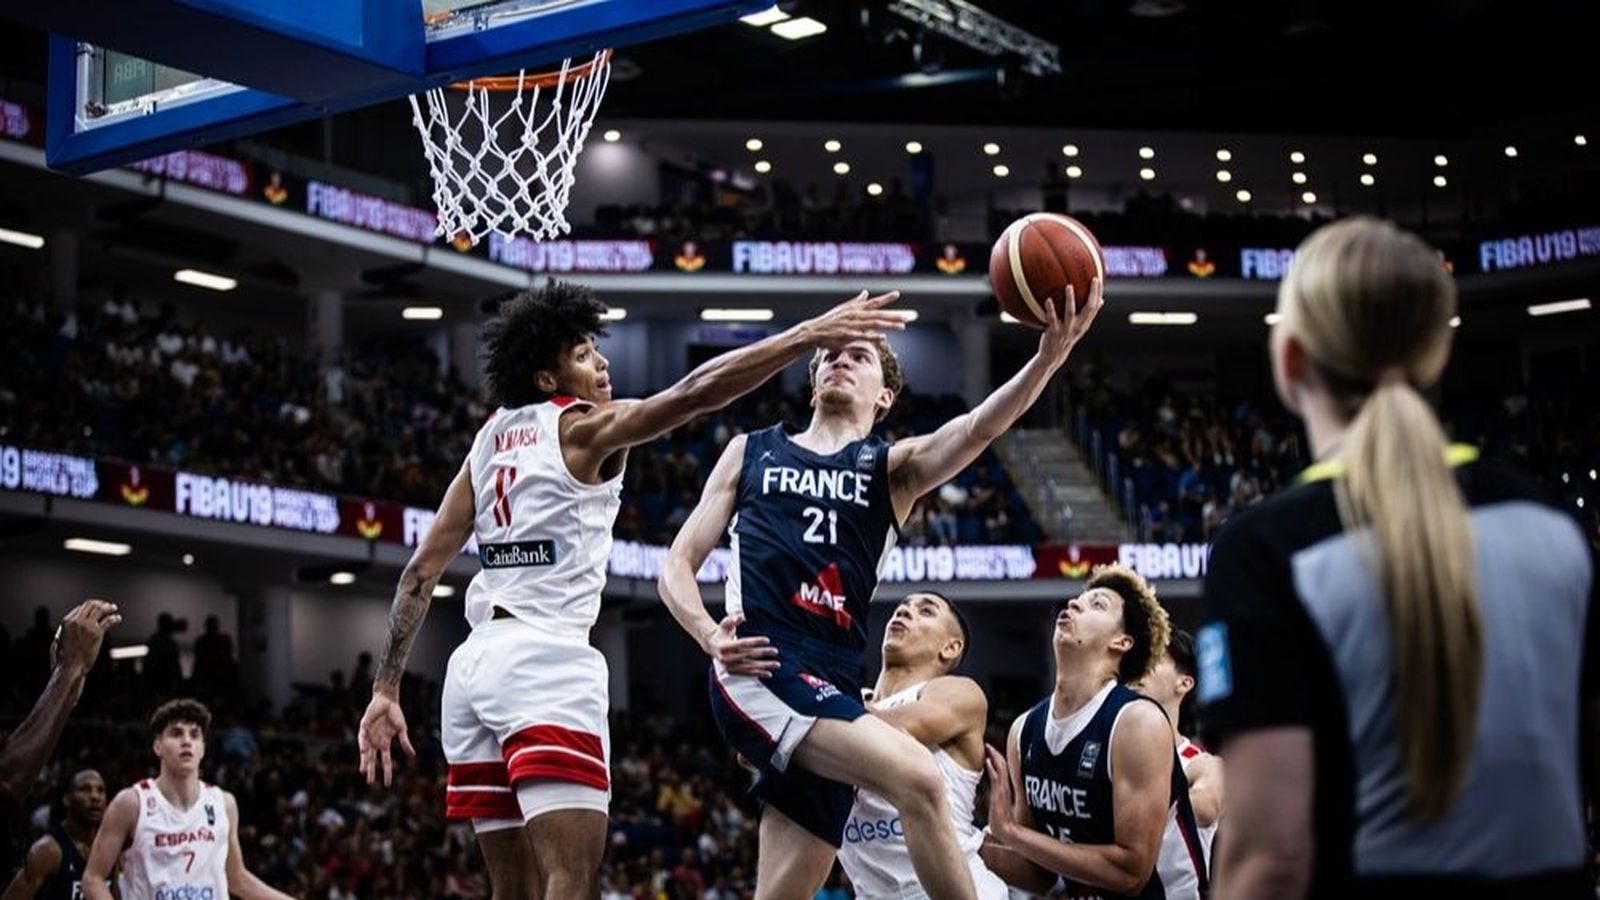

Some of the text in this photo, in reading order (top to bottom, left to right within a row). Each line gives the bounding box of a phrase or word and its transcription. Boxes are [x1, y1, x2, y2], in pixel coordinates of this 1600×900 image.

[732, 240, 793, 273] FIBA
[793, 240, 840, 273] U19
[1480, 234, 1535, 272] FIBA
[1535, 229, 1577, 263] U19
[175, 471, 274, 526] FIBA U19
[762, 466, 873, 507] FRANCE
[802, 506, 838, 545] 21
[905, 545, 954, 581] U19
[1025, 775, 1092, 819] FRANCE
[154, 828, 216, 848] ESPAÑA
[183, 851, 196, 873] 7
